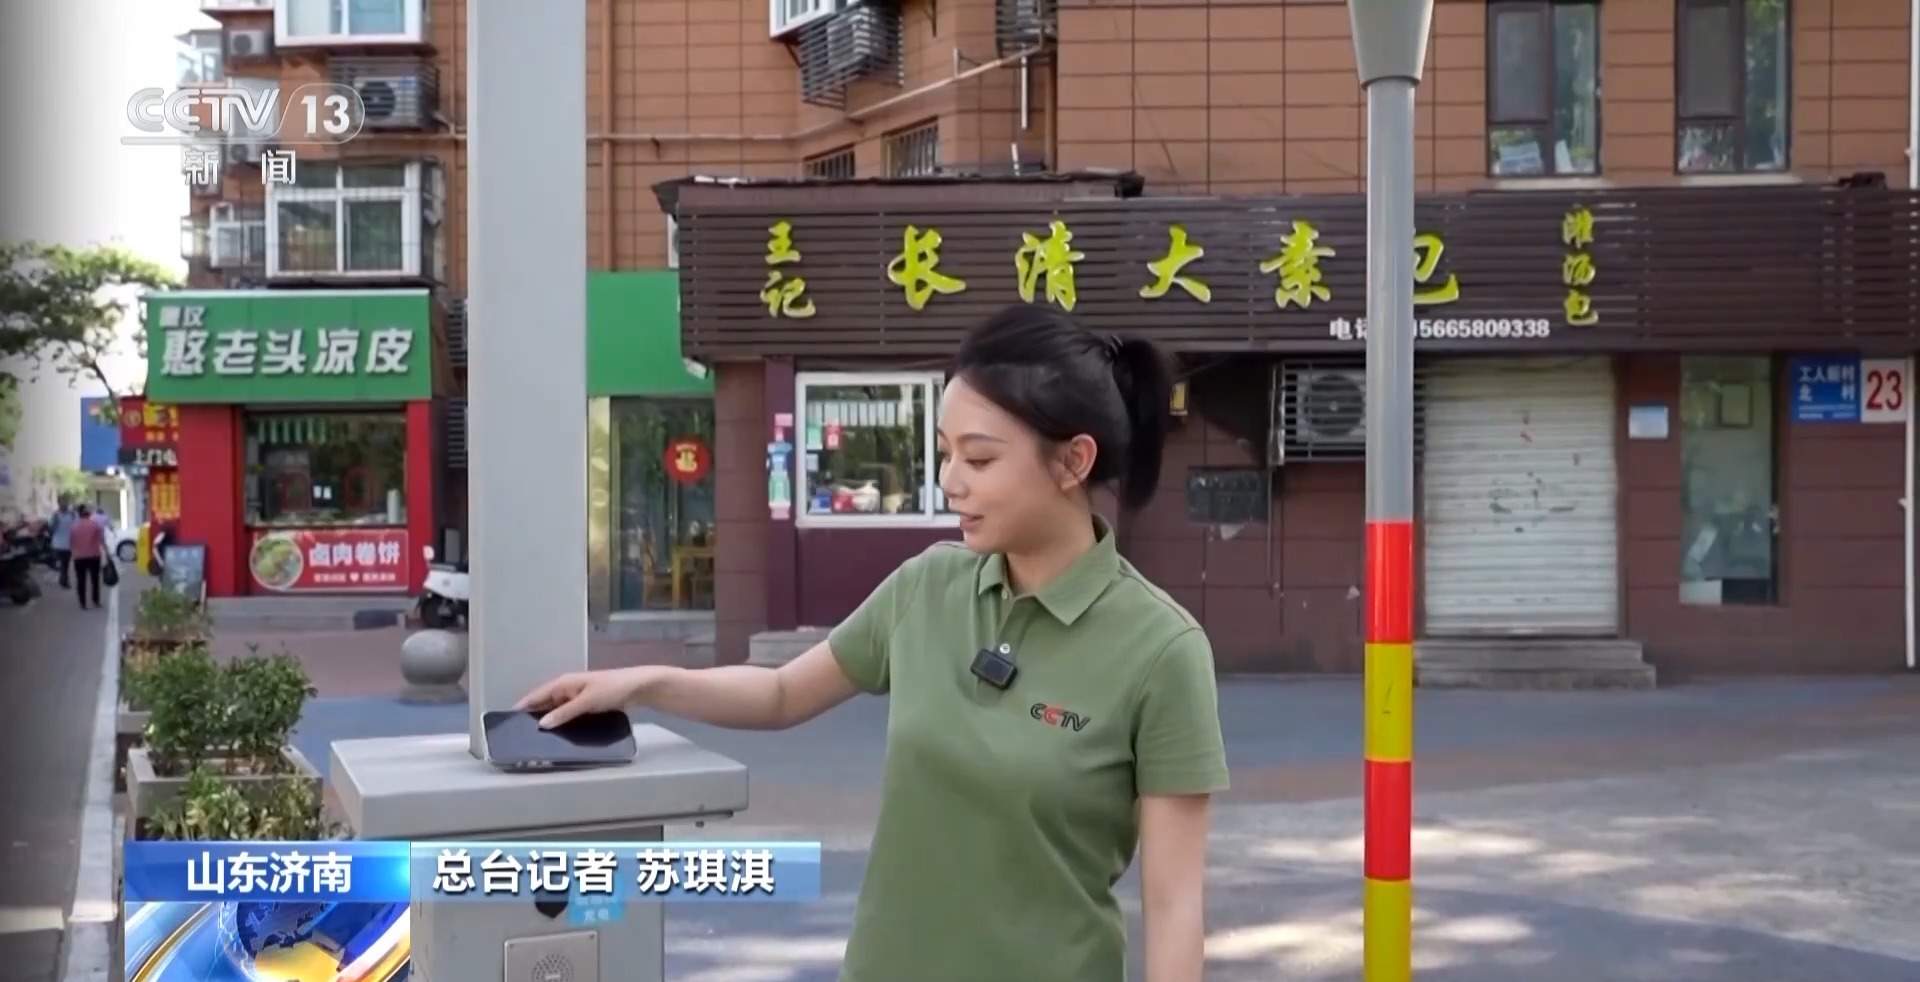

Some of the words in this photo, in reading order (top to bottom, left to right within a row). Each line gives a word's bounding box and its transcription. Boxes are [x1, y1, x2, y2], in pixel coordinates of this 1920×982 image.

[760, 221, 816, 318] 王记
[160, 327, 413, 375] 憨老头凉皮
[1799, 365, 1855, 383] 工人村
[1866, 369, 1903, 411] 23
[1030, 702, 1091, 732] CCTV
